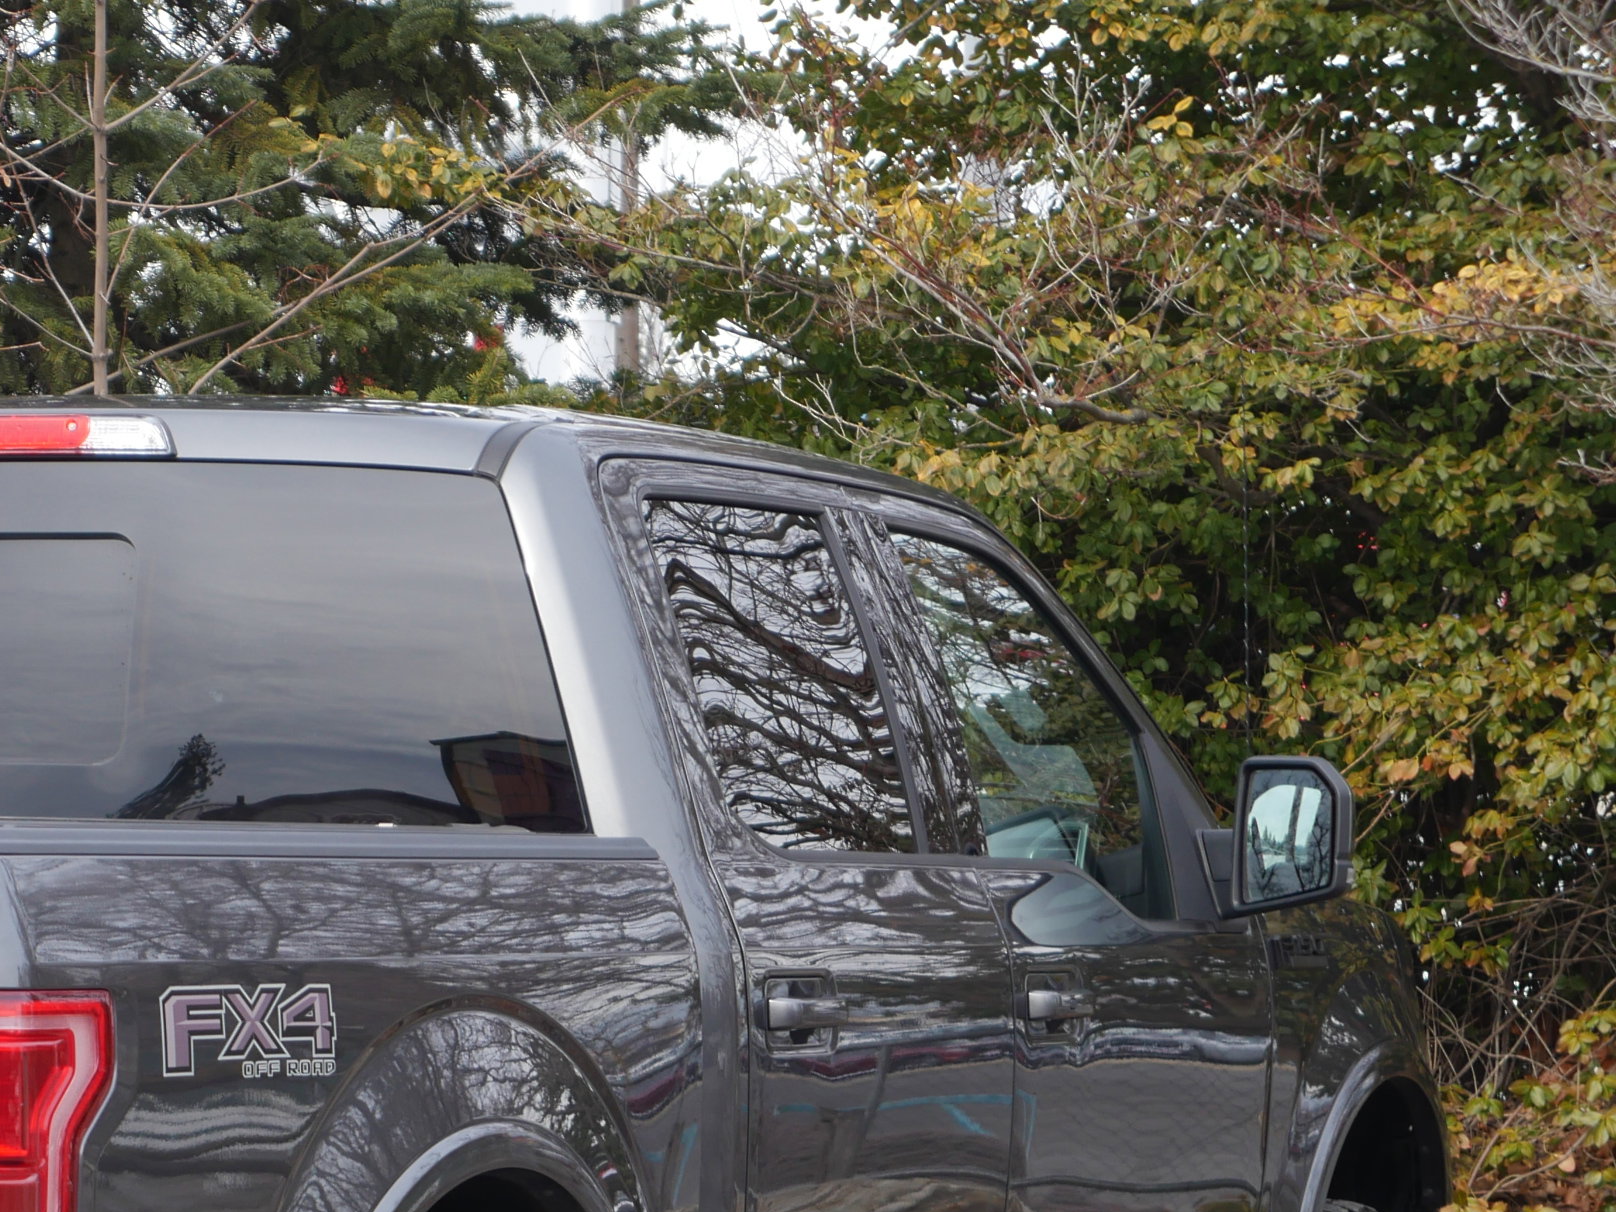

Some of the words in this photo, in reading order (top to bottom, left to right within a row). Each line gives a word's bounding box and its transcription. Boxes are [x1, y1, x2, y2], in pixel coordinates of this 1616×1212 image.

[159, 983, 338, 1078] FX4
[241, 1060, 281, 1079] OFF
[286, 1058, 337, 1077] ROAD
